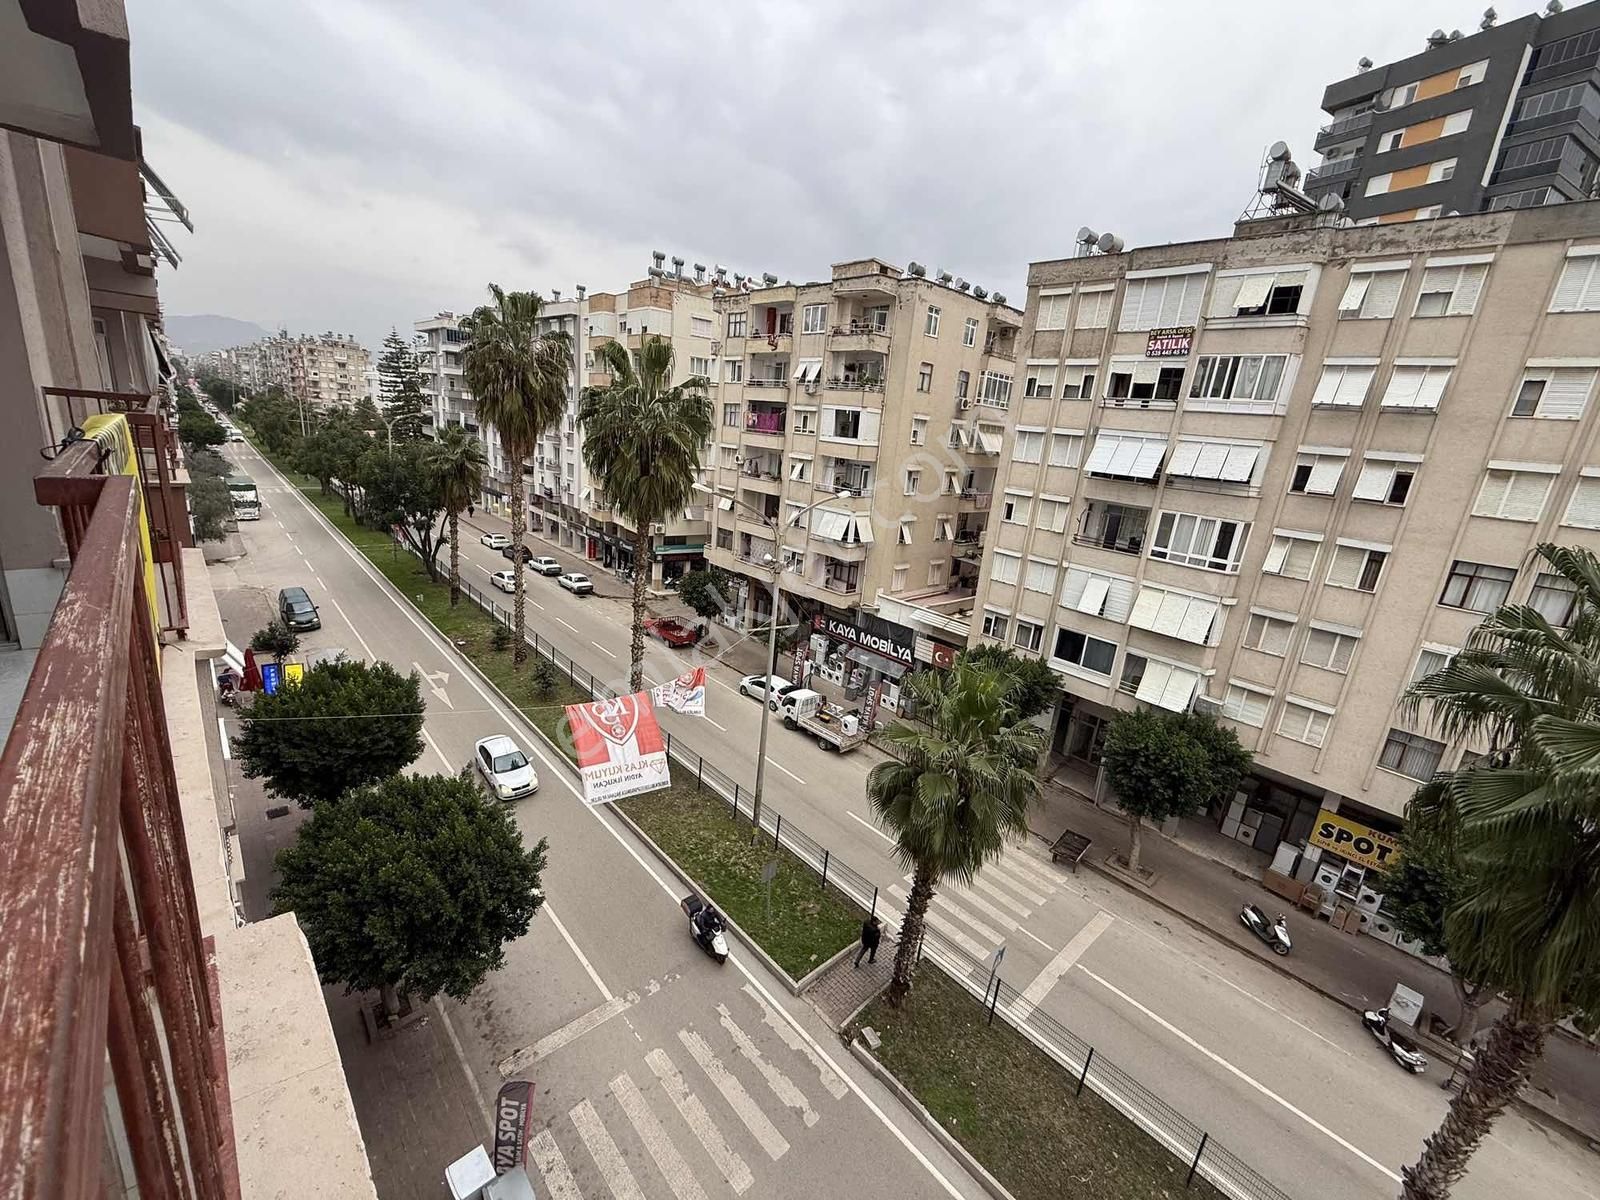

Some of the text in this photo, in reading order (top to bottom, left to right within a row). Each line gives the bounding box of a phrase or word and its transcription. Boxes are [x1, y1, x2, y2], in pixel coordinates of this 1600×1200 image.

[1148, 337, 1189, 350] SATILIK
[828, 619, 912, 663] KAYA MOBİLYA
[867, 686, 877, 705] SPOT
[1318, 822, 1393, 863] SPOT
[499, 1097, 519, 1141] SPOT
